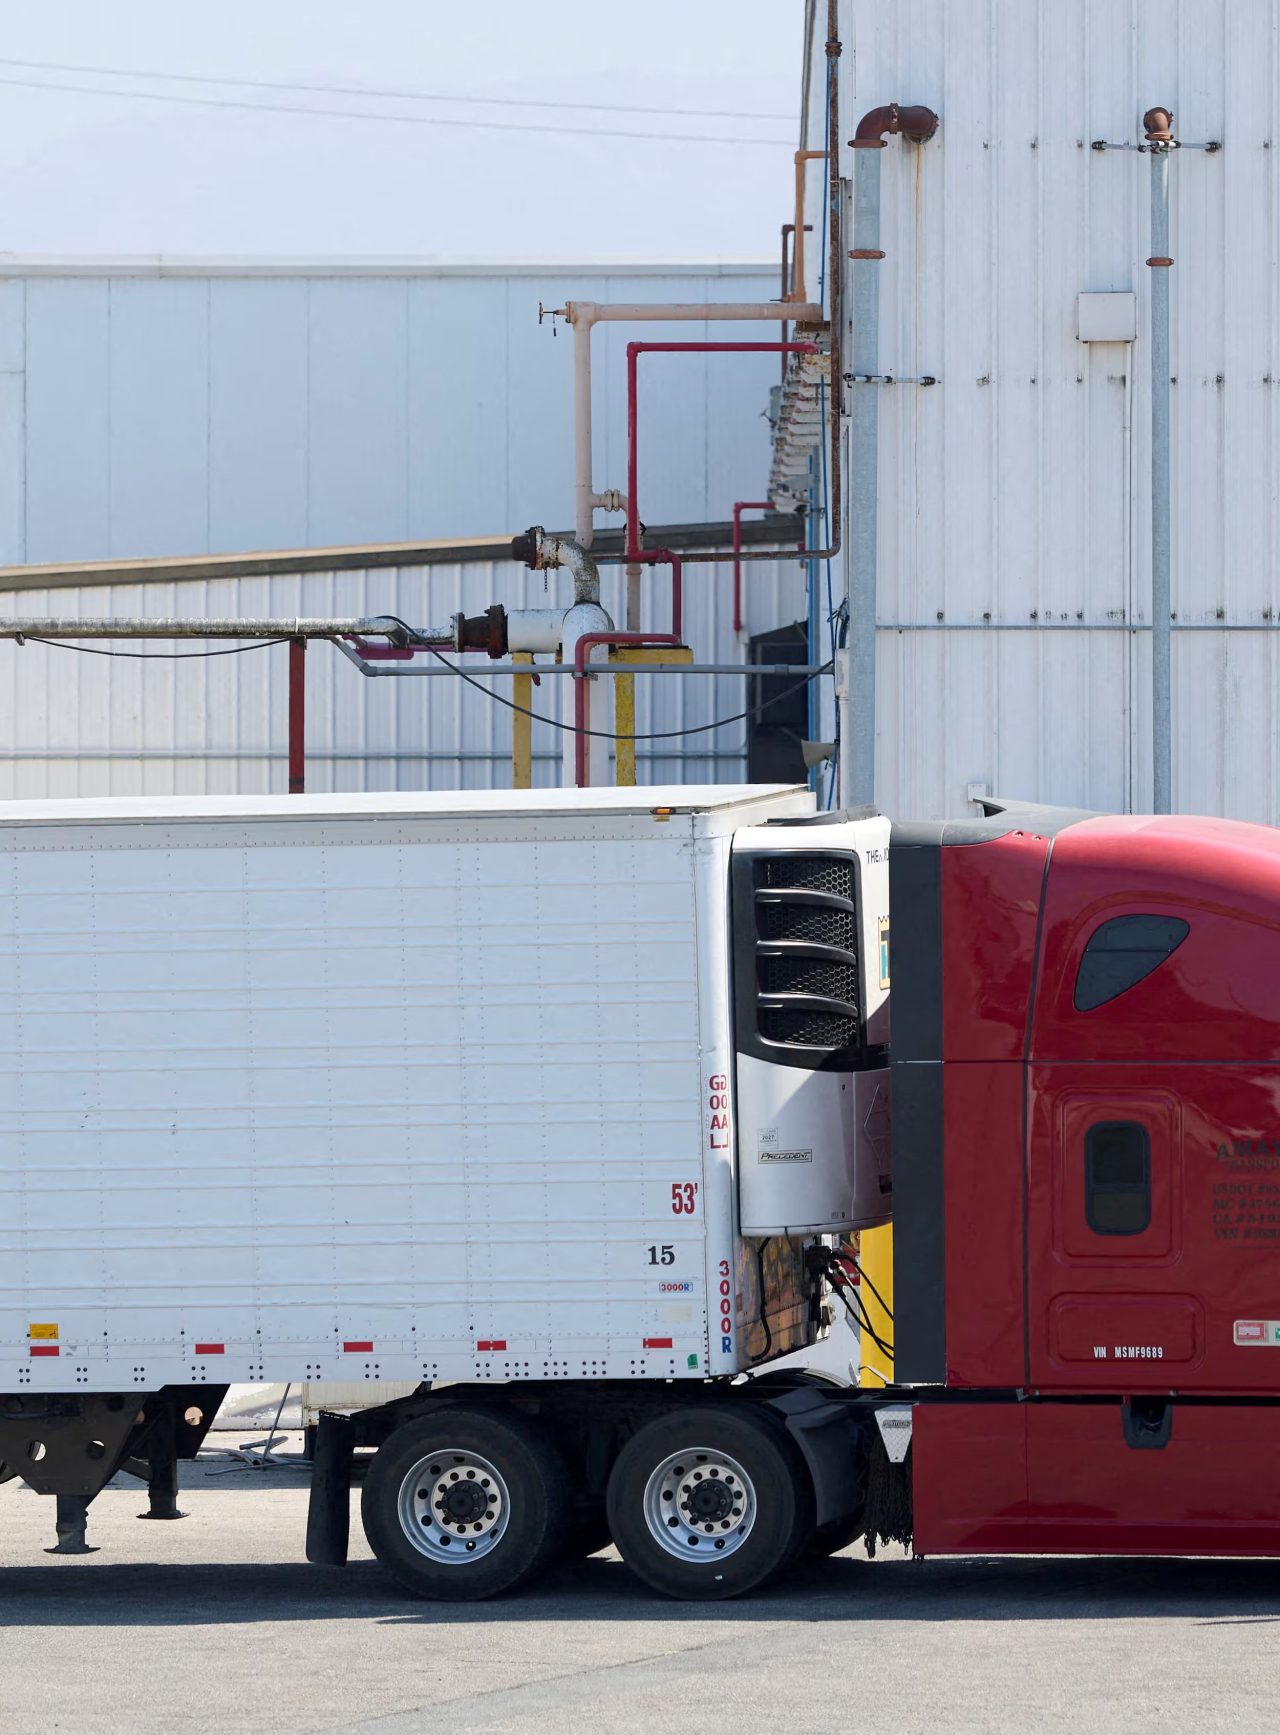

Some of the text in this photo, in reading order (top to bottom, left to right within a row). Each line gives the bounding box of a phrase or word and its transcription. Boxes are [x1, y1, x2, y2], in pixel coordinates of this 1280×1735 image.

[672, 1183, 698, 1214] 53'
[647, 1245, 675, 1265] 15
[661, 1283, 690, 1292] 3000R
[1094, 1346, 1107, 1358] VIN
